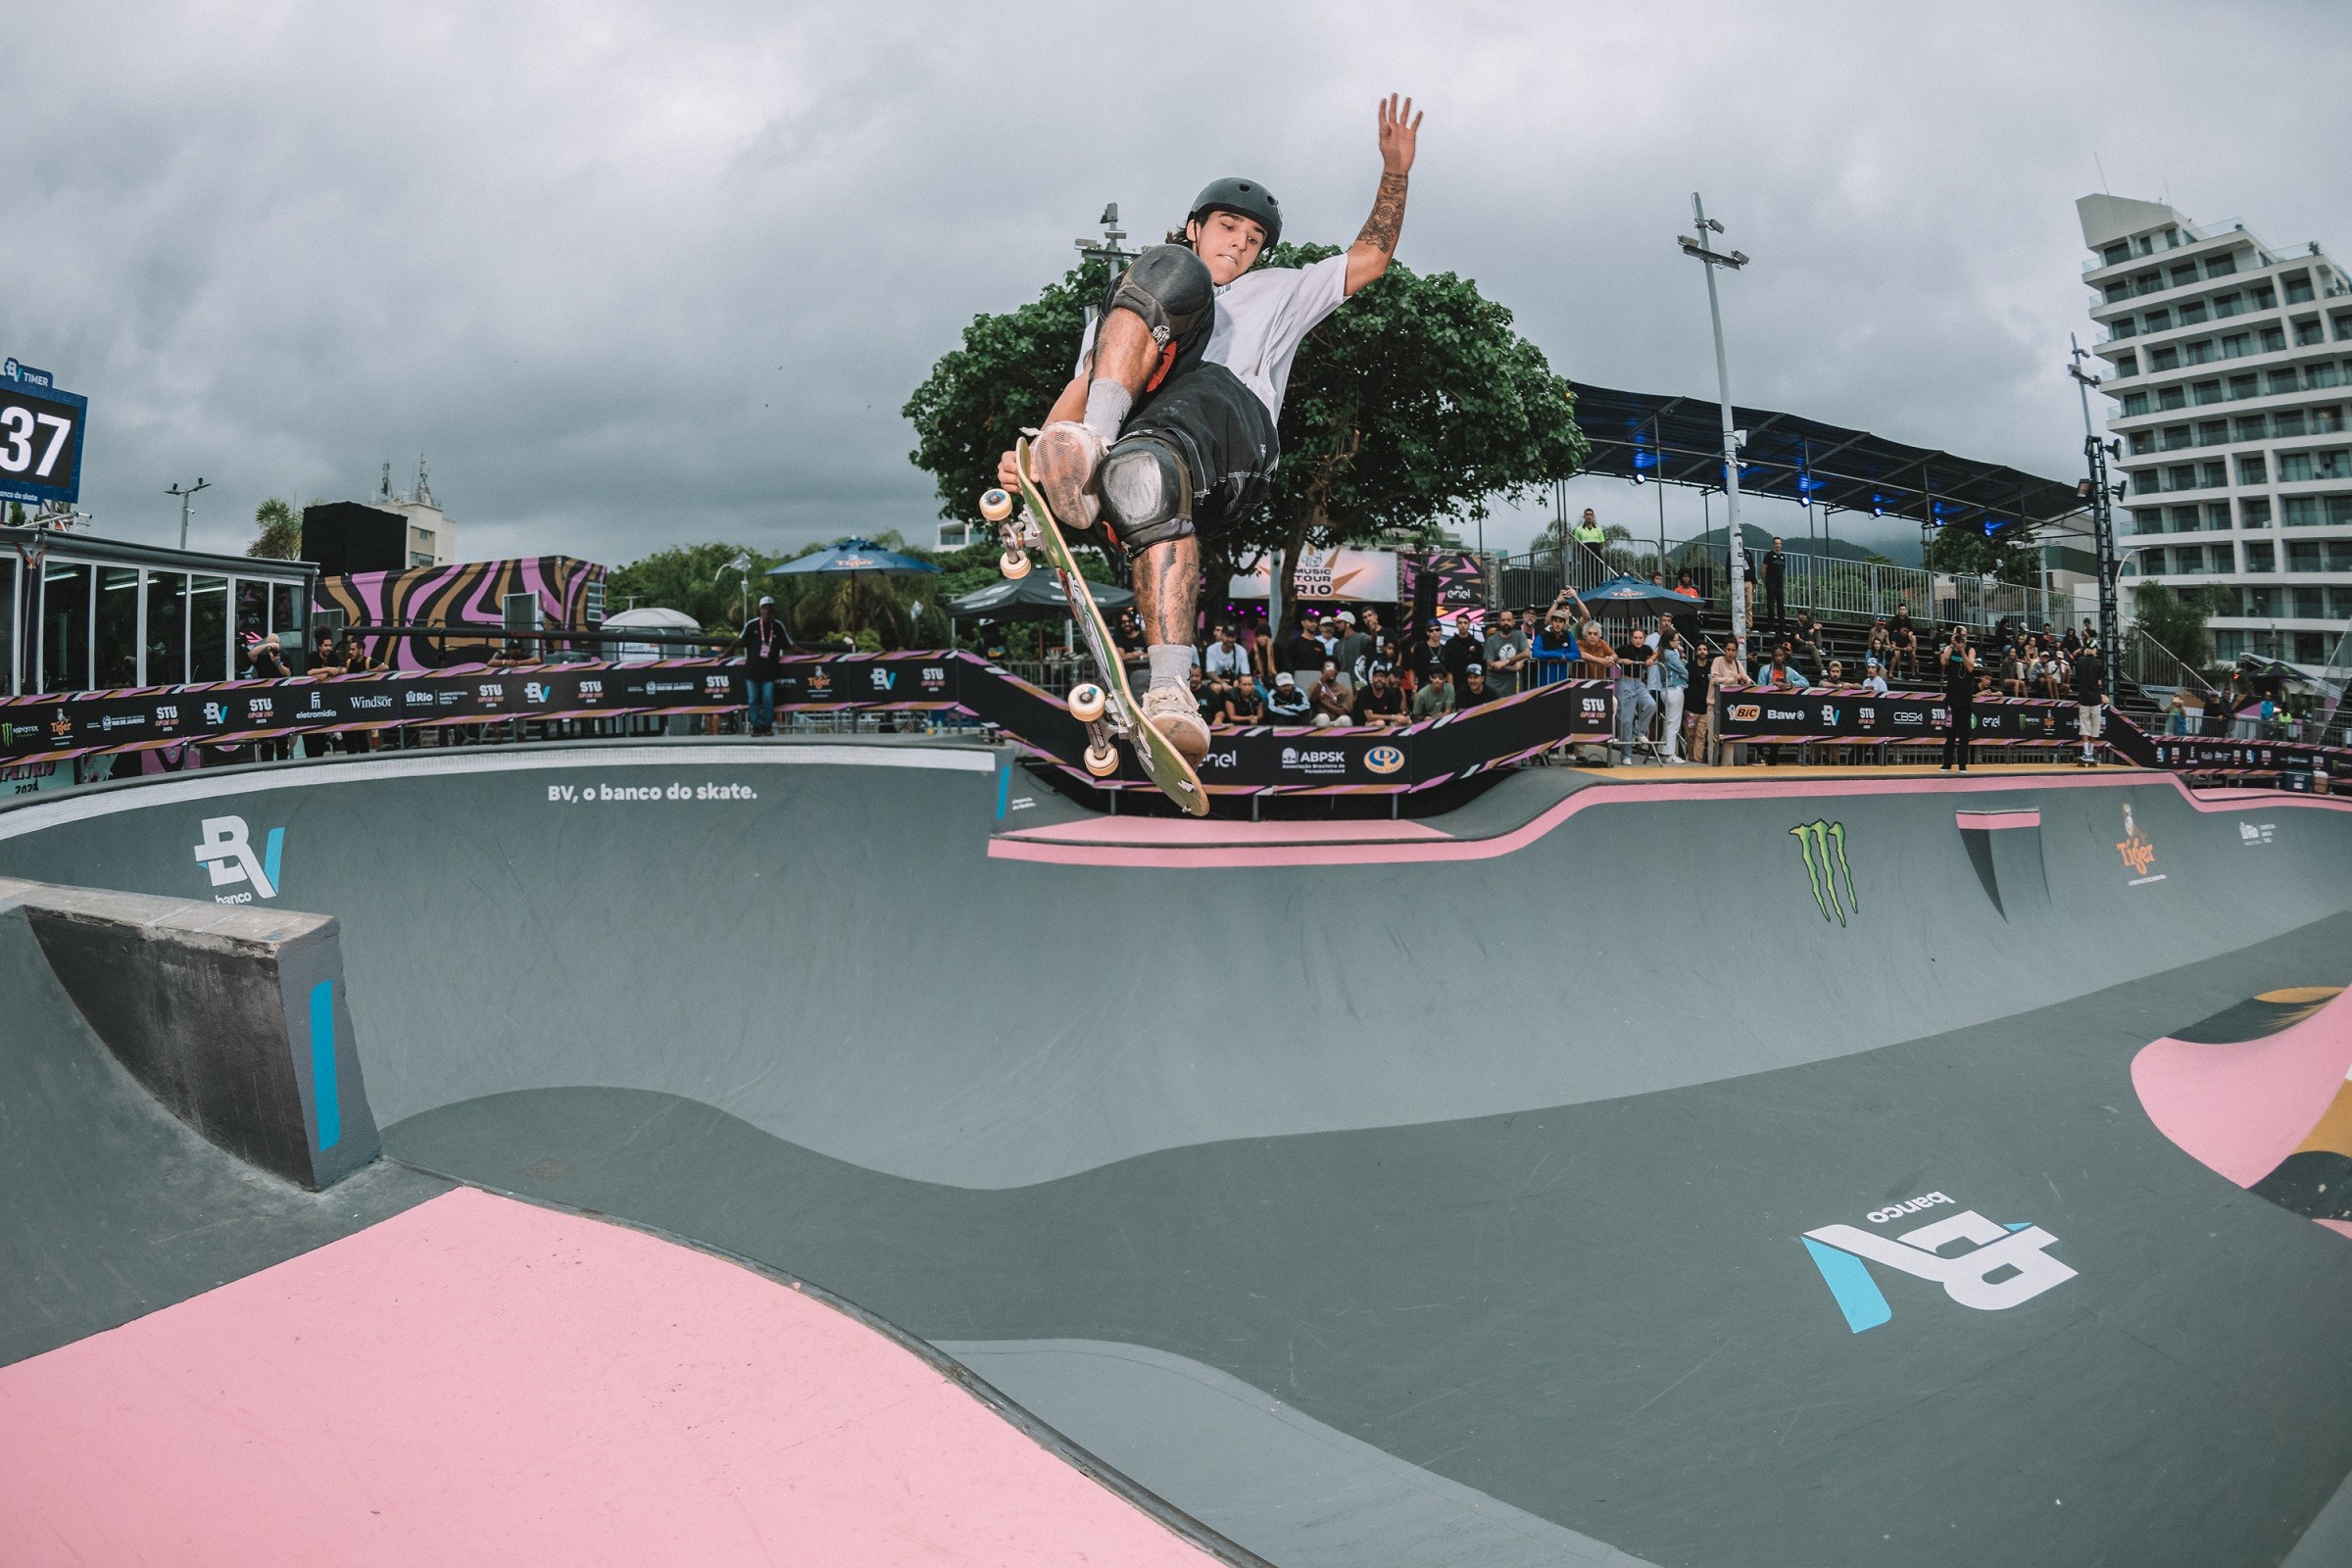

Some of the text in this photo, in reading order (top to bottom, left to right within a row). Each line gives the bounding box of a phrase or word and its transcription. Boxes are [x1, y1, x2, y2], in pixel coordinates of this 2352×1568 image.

[24, 371, 49, 387] TIMER
[0, 406, 72, 477] 37
[1295, 584, 1332, 595] RIO
[1447, 589, 1470, 599] enel
[922, 667, 945, 680] STU
[579, 681, 602, 693] STU
[706, 675, 729, 688] STU
[808, 677, 830, 689] Tiger
[416, 692, 433, 702] Rio
[479, 684, 503, 697] STU
[249, 698, 272, 711] STU
[350, 696, 392, 709] Windsor
[1582, 698, 1605, 711] STU
[156, 706, 177, 719] STU
[1859, 708, 1875, 718] STU
[51, 720, 72, 735] Tiger
[1983, 715, 2000, 727] enel
[13, 725, 38, 734] MONSTER
[1300, 752, 1345, 762] ABPSK
[548, 782, 758, 804] BV, o banco do skate.
[2117, 837, 2155, 875] Tiger
[1866, 1191, 1956, 1224] banco
